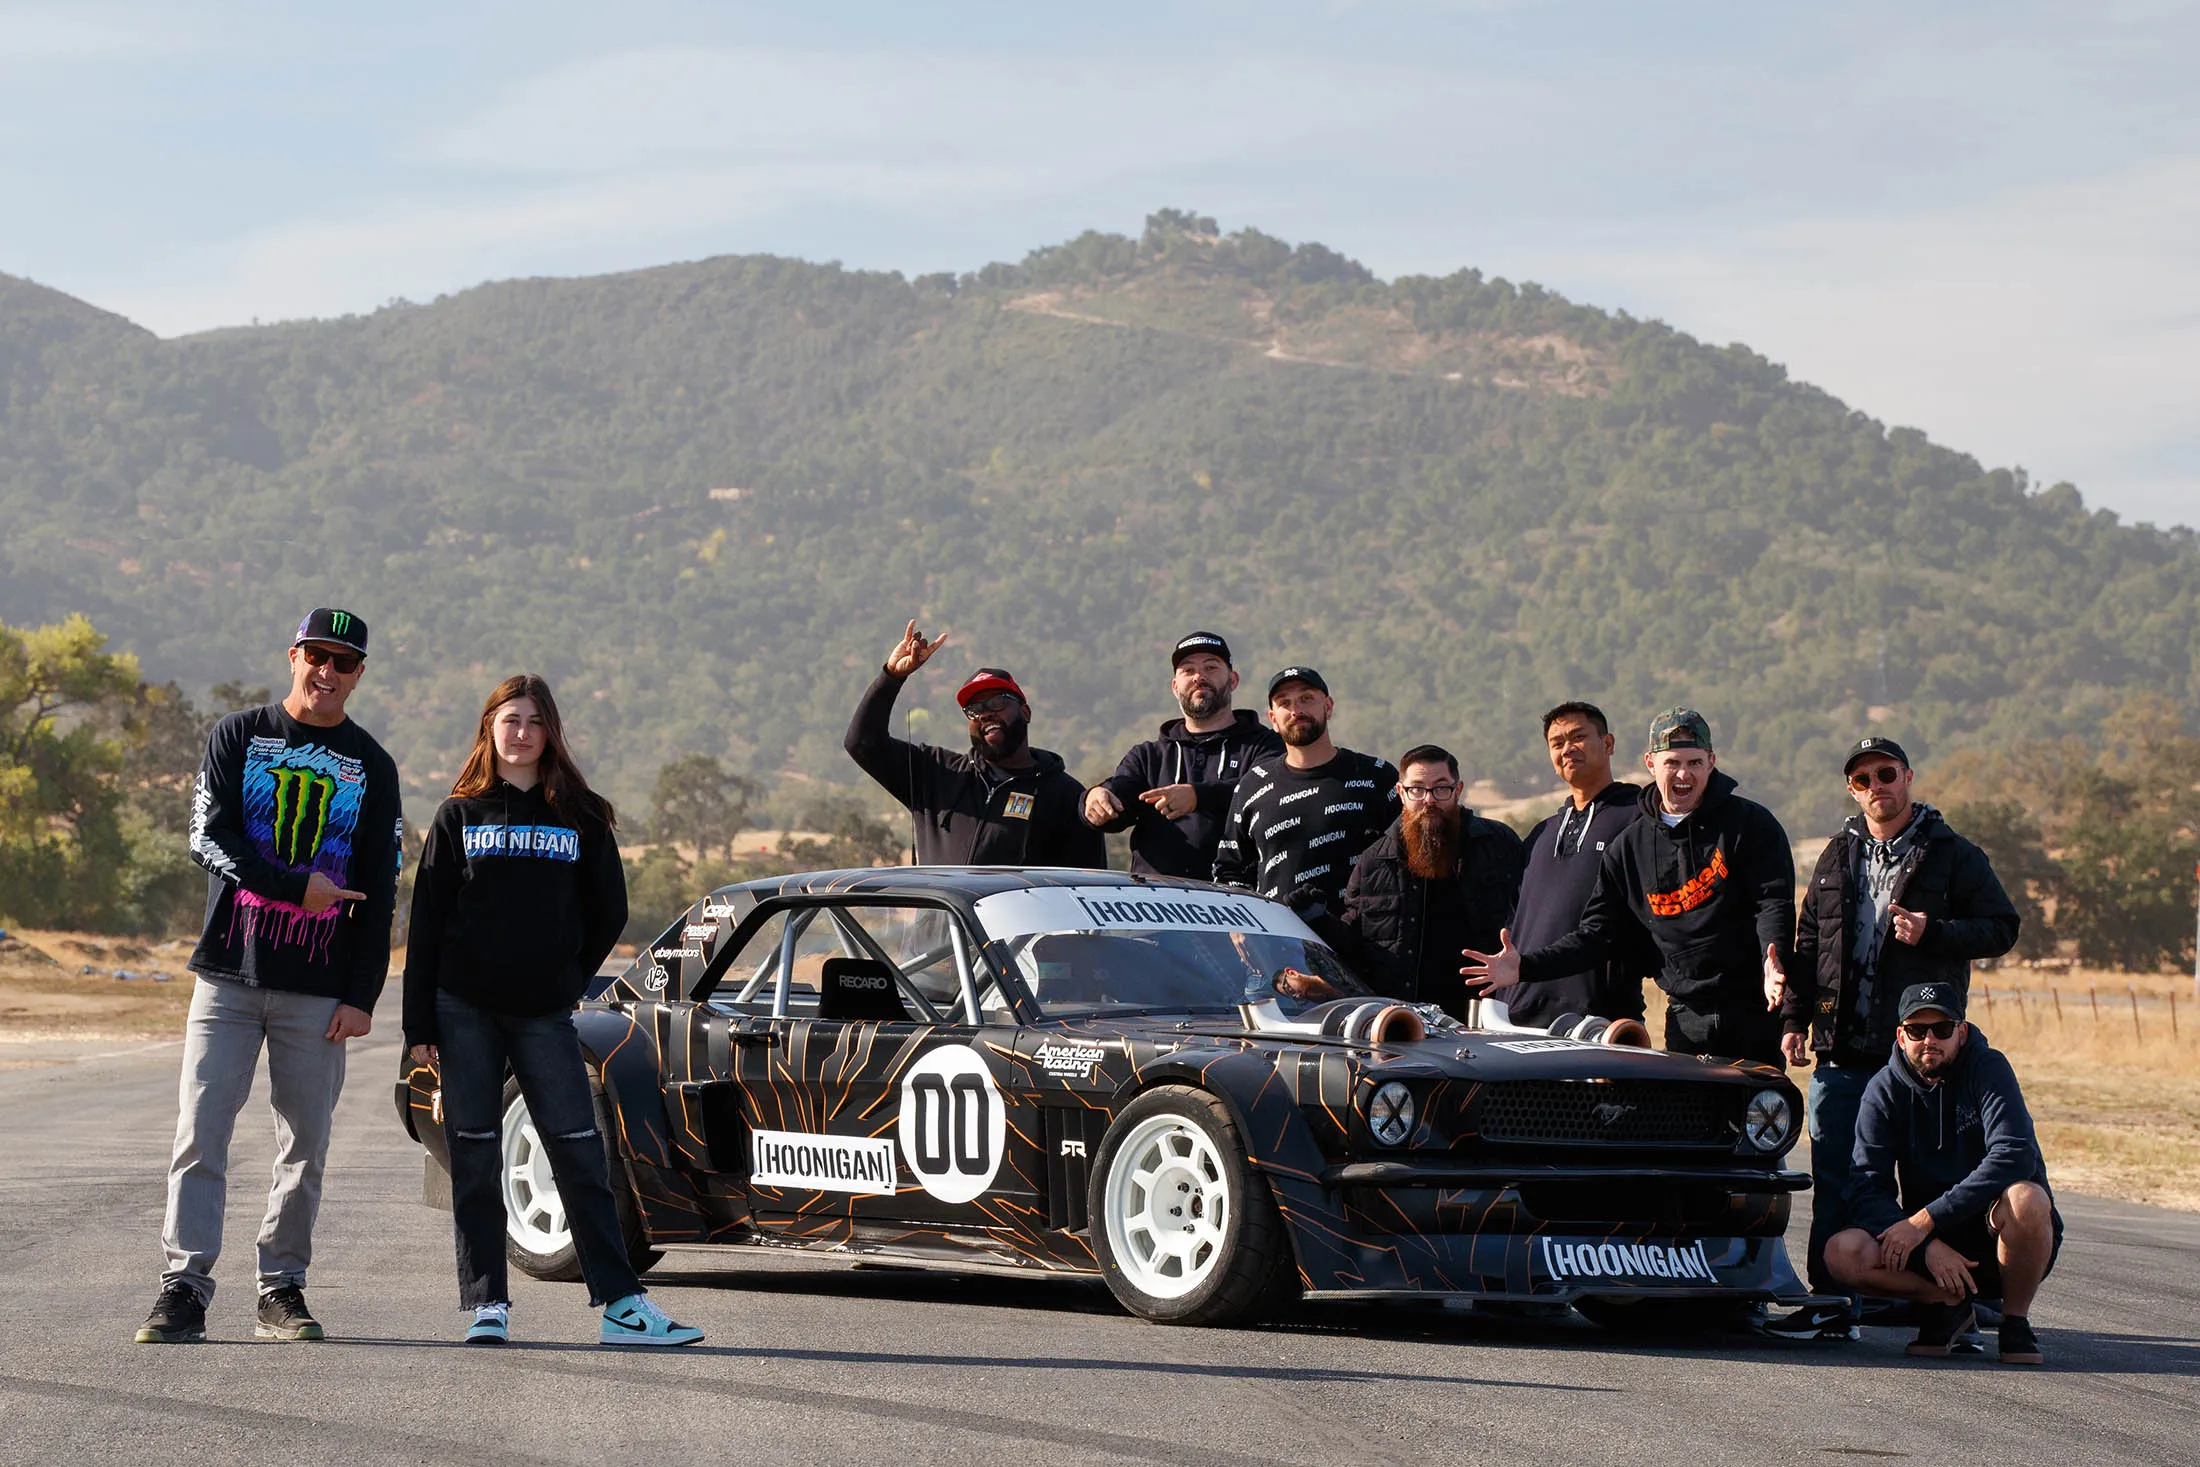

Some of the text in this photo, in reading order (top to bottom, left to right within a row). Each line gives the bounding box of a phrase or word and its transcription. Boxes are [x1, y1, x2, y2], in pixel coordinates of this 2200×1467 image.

[1279, 786, 1319, 806] HOONIGAN
[1324, 802, 1363, 815] HOONIGAN
[1265, 816, 1301, 840] HOONIGAN
[1309, 830, 1346, 849] HOONIGAN
[1295, 864, 1331, 884] HOONIGAN
[839, 974, 887, 990] RECARO
[1033, 1040, 1105, 1060] American
[1043, 1057, 1093, 1078] Racing
[911, 1072, 990, 1175] 00
